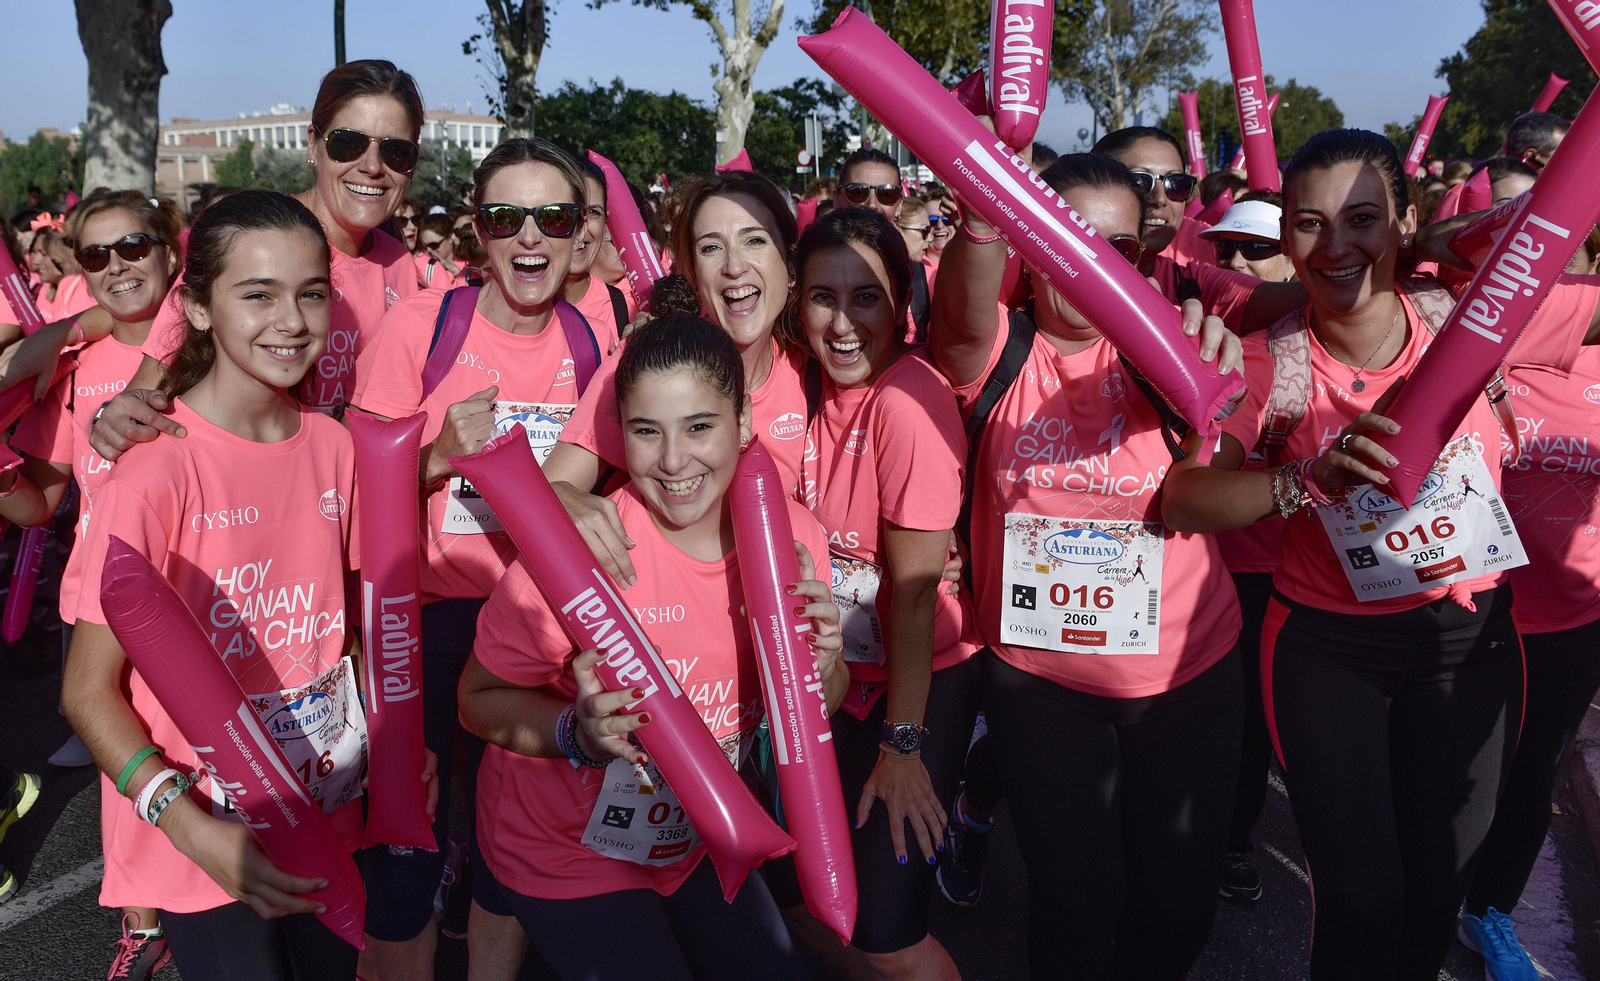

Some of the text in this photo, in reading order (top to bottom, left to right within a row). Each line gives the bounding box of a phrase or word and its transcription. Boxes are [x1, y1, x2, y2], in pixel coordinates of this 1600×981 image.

[999, 0, 1045, 115] Ladival
[1237, 75, 1267, 136] Ladival
[953, 157, 1080, 279] Protección solar en profundidad
[1459, 212, 1571, 344] Ladival
[77, 380, 127, 397] OYSHO
[1022, 411, 1074, 442] HOY
[1015, 435, 1109, 475] GANAN
[1005, 459, 1167, 497] LAS CHICAS
[1423, 492, 1457, 509] Carrera
[192, 506, 259, 533] OYSHO
[453, 514, 490, 523] OYSHO
[1384, 516, 1456, 552] 016
[1050, 539, 1118, 557] ASTURIANA
[1410, 546, 1445, 565] 2057
[1482, 554, 1513, 567] ZURICH
[212, 558, 273, 597] HOY
[1097, 565, 1127, 574] Carrera
[1114, 574, 1135, 587] Mujer
[1430, 562, 1458, 576] Santander
[1049, 582, 1114, 609] 016
[1361, 577, 1402, 592] OYSHO
[210, 583, 315, 629] GANAN
[1063, 612, 1097, 626] 2060
[1009, 623, 1102, 642] OYSHO Santander
[380, 592, 420, 703] Ladival
[561, 586, 660, 711] Ladival
[664, 656, 699, 684] OY
[769, 614, 804, 764] Protección solar en profundidad
[271, 703, 331, 735] ASTURIANA
[223, 719, 300, 828] Protección solar en profundidad
[647, 801, 687, 825] 01
[593, 835, 635, 851] OYSHO
[656, 827, 689, 841] 3368
